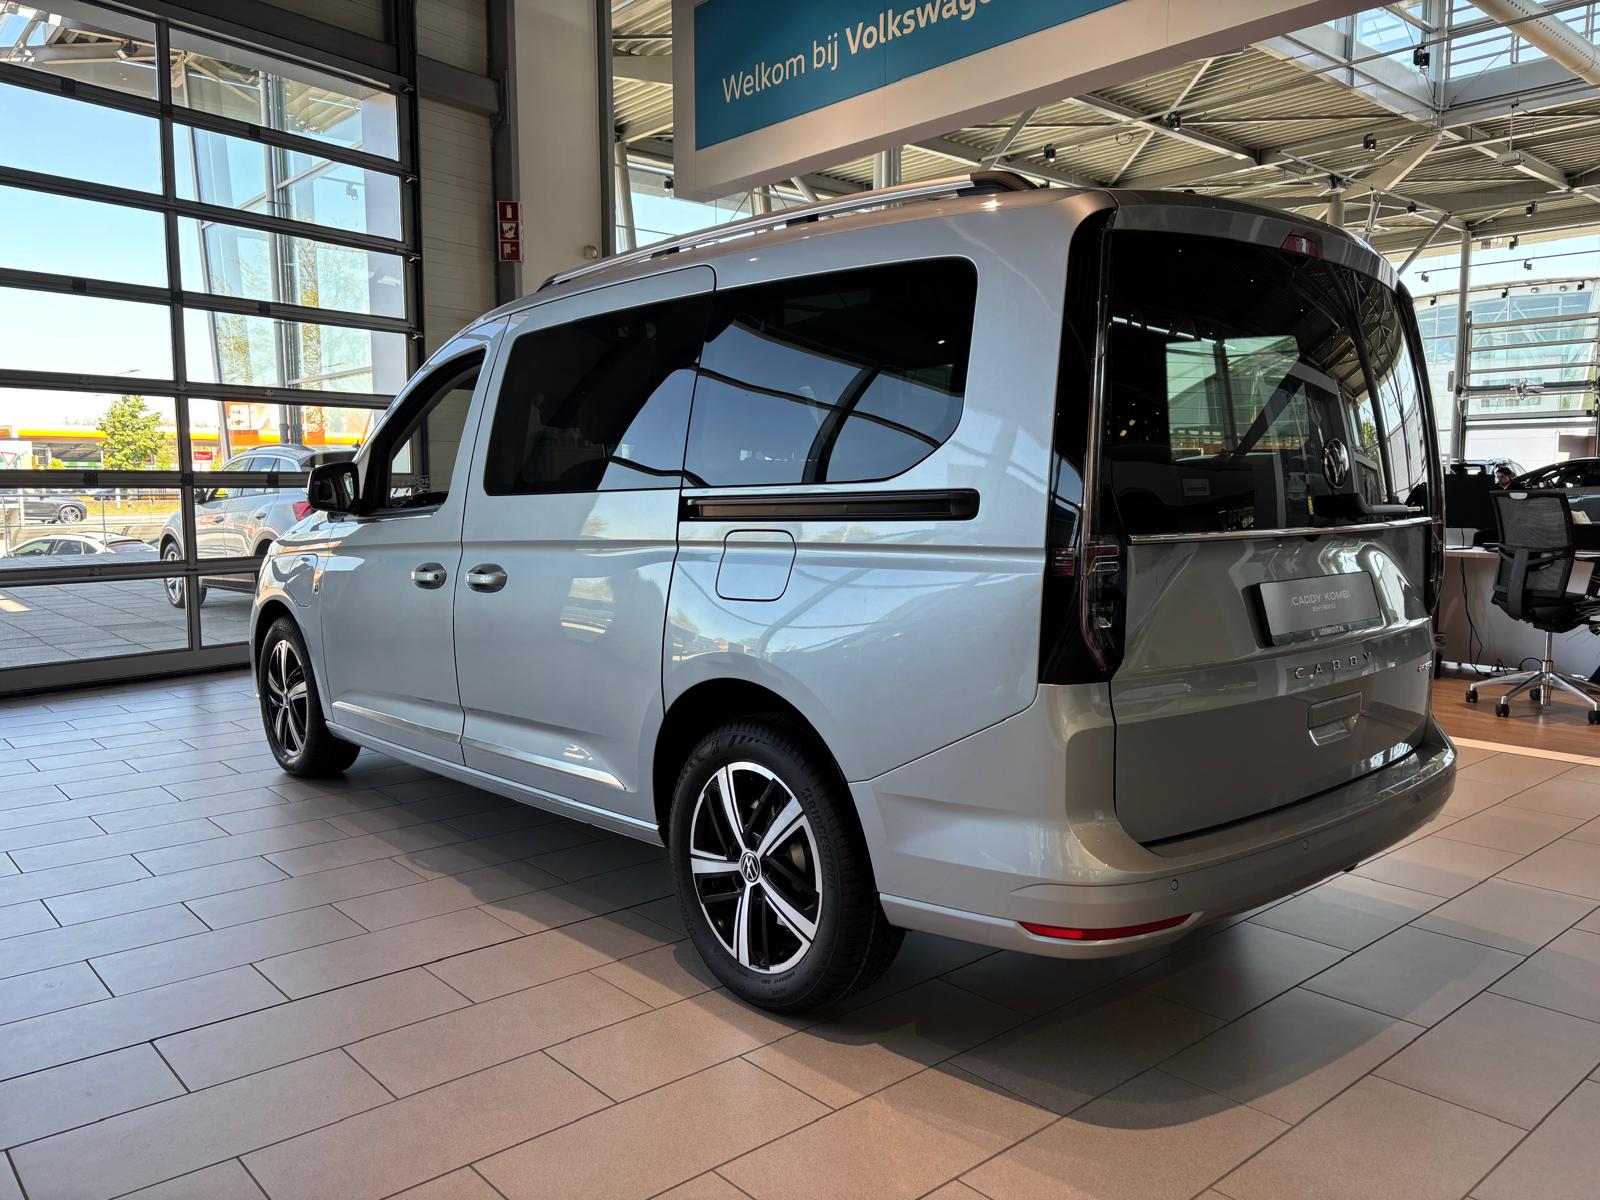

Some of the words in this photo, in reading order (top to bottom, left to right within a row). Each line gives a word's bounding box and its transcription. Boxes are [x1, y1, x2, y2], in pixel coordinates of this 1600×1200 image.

[722, 52, 805, 103] Welkom
[812, 32, 838, 71] bij
[845, 0, 993, 55] Volkswag
[1291, 593, 1321, 606] CADDY
[1323, 590, 1351, 601] KOMBI
[1295, 651, 1372, 679] CADDY
